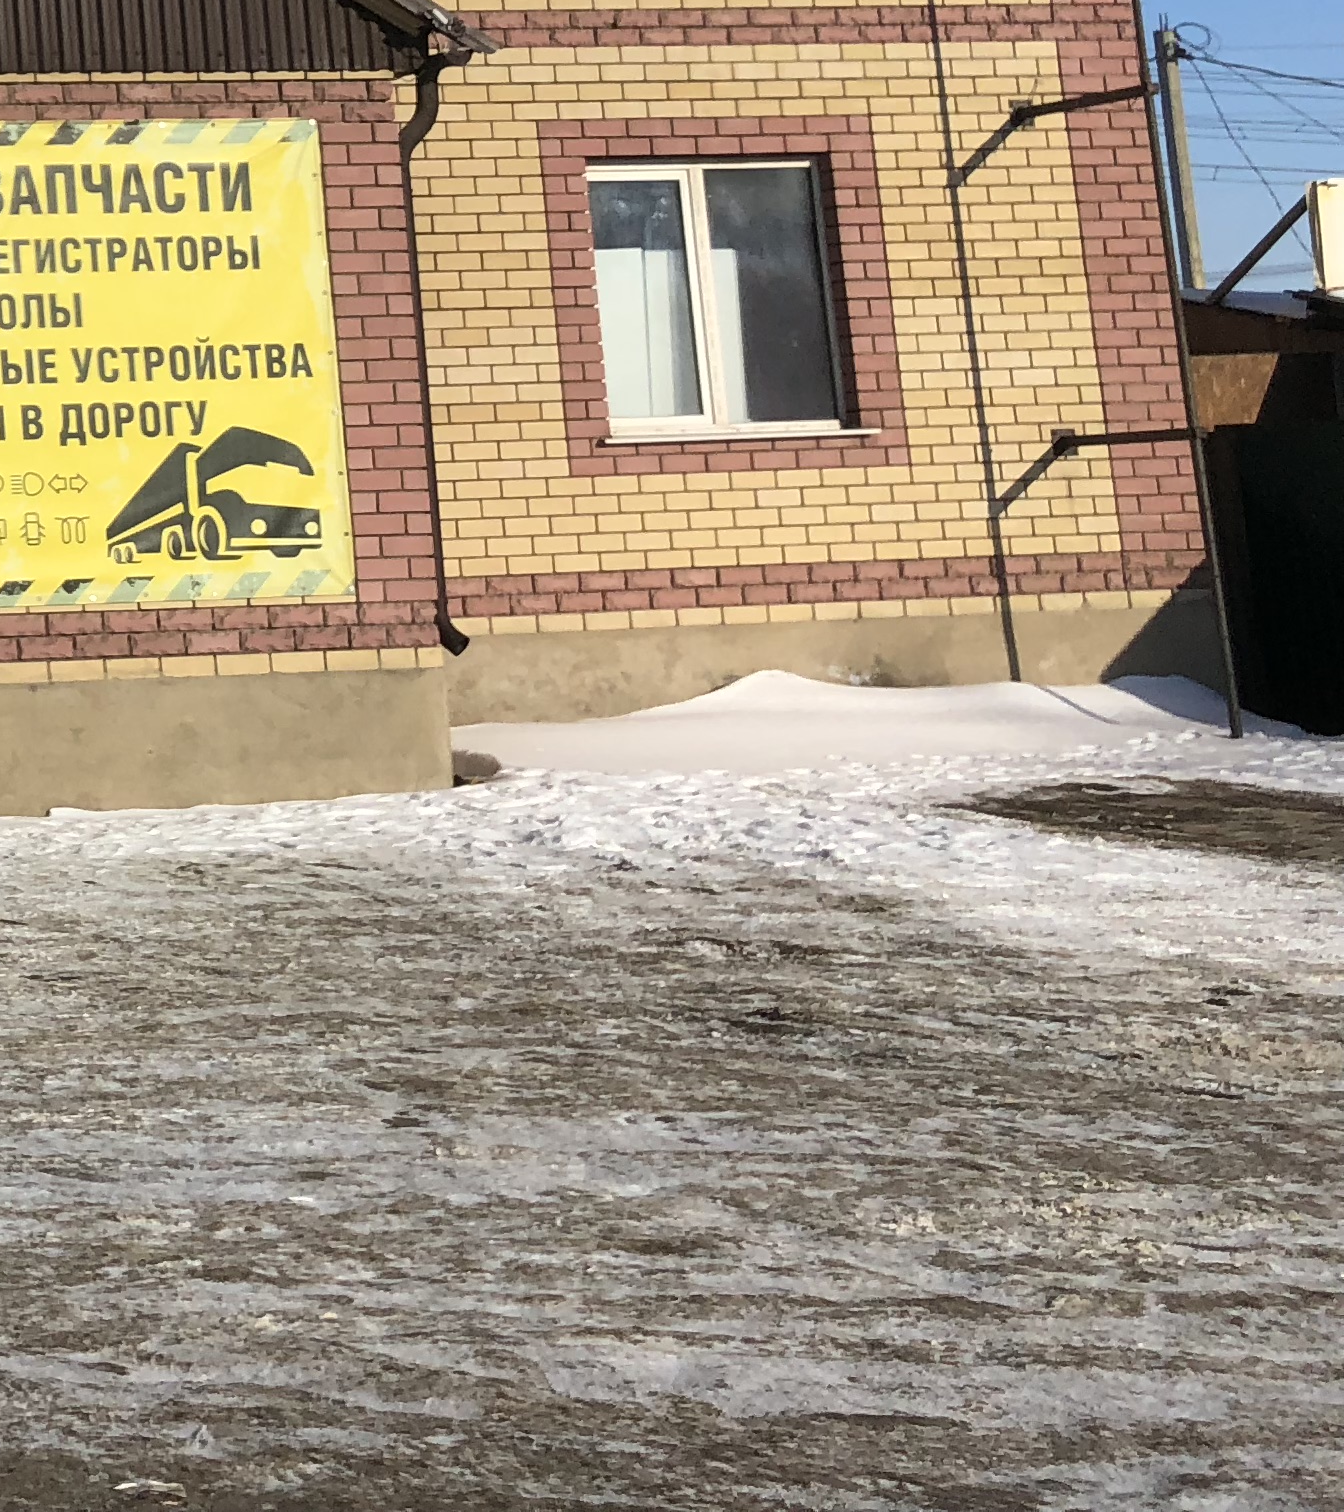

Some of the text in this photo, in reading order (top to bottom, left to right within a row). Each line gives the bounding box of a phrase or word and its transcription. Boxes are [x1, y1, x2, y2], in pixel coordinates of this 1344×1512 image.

[71, 335, 314, 384] УСТРОЙСТВА
[21, 404, 44, 441] В
[59, 400, 207, 448] ДОРОГУ
